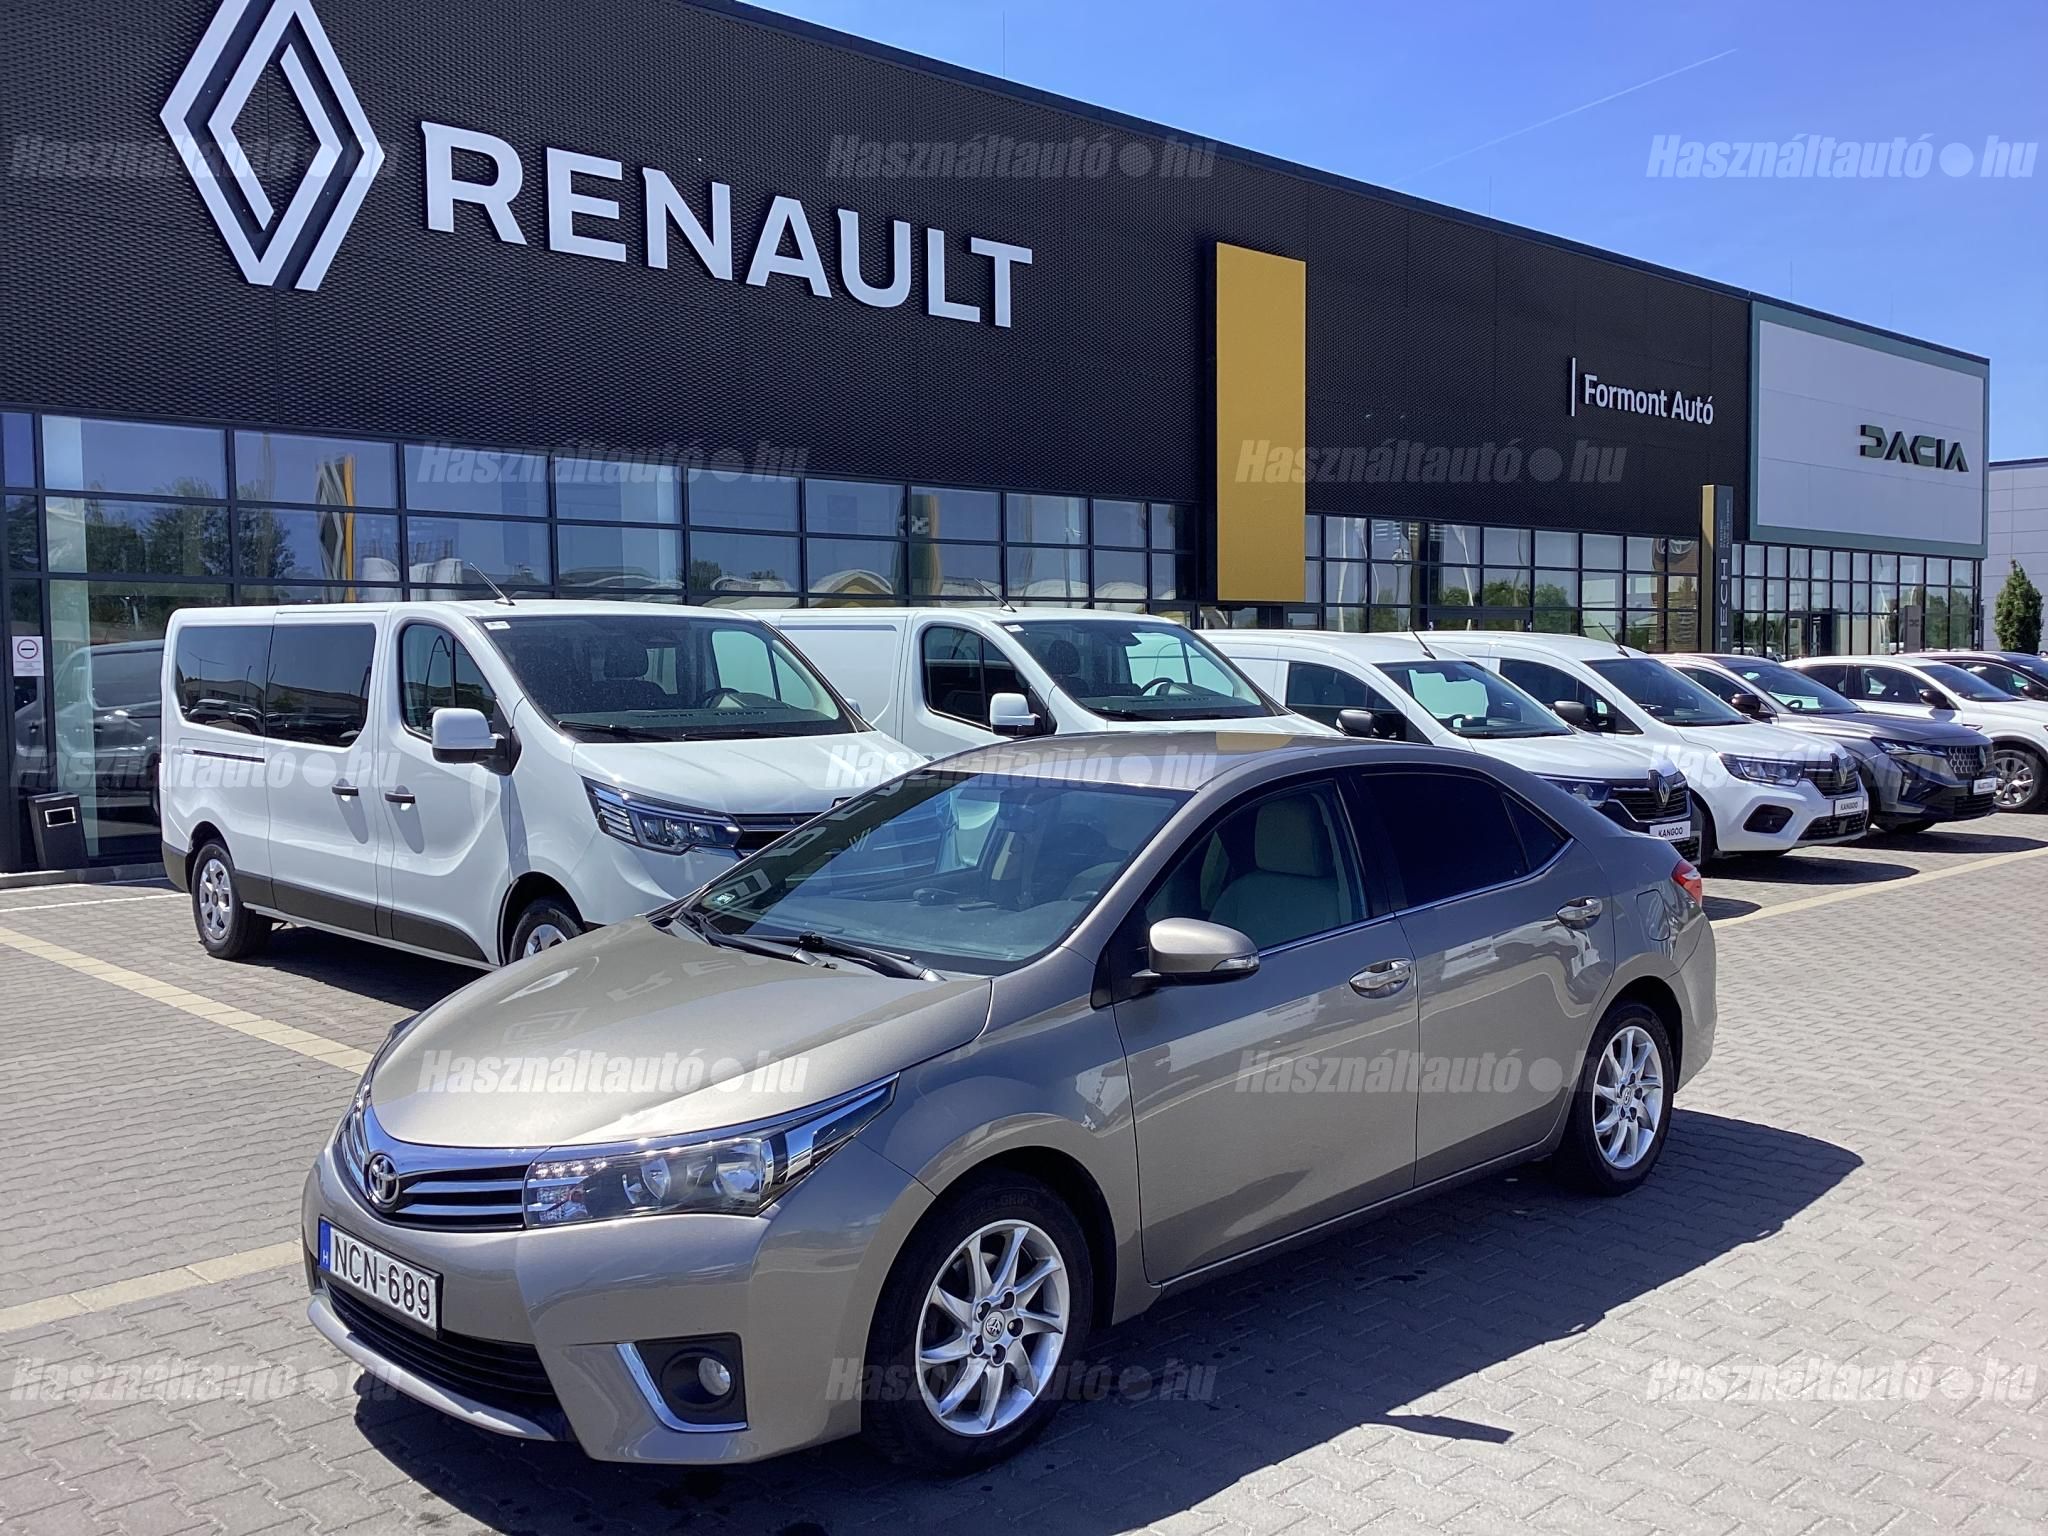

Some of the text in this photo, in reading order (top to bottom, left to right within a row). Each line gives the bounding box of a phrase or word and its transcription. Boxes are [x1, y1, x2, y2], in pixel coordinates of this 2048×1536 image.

[421, 120, 1032, 327] RENAULT
[1585, 374, 1714, 425] Formont Autó
[1860, 424, 1969, 472] DACIA
[1658, 826, 1683, 837] KANGOO
[322, 1235, 429, 1320] H NCN-689
